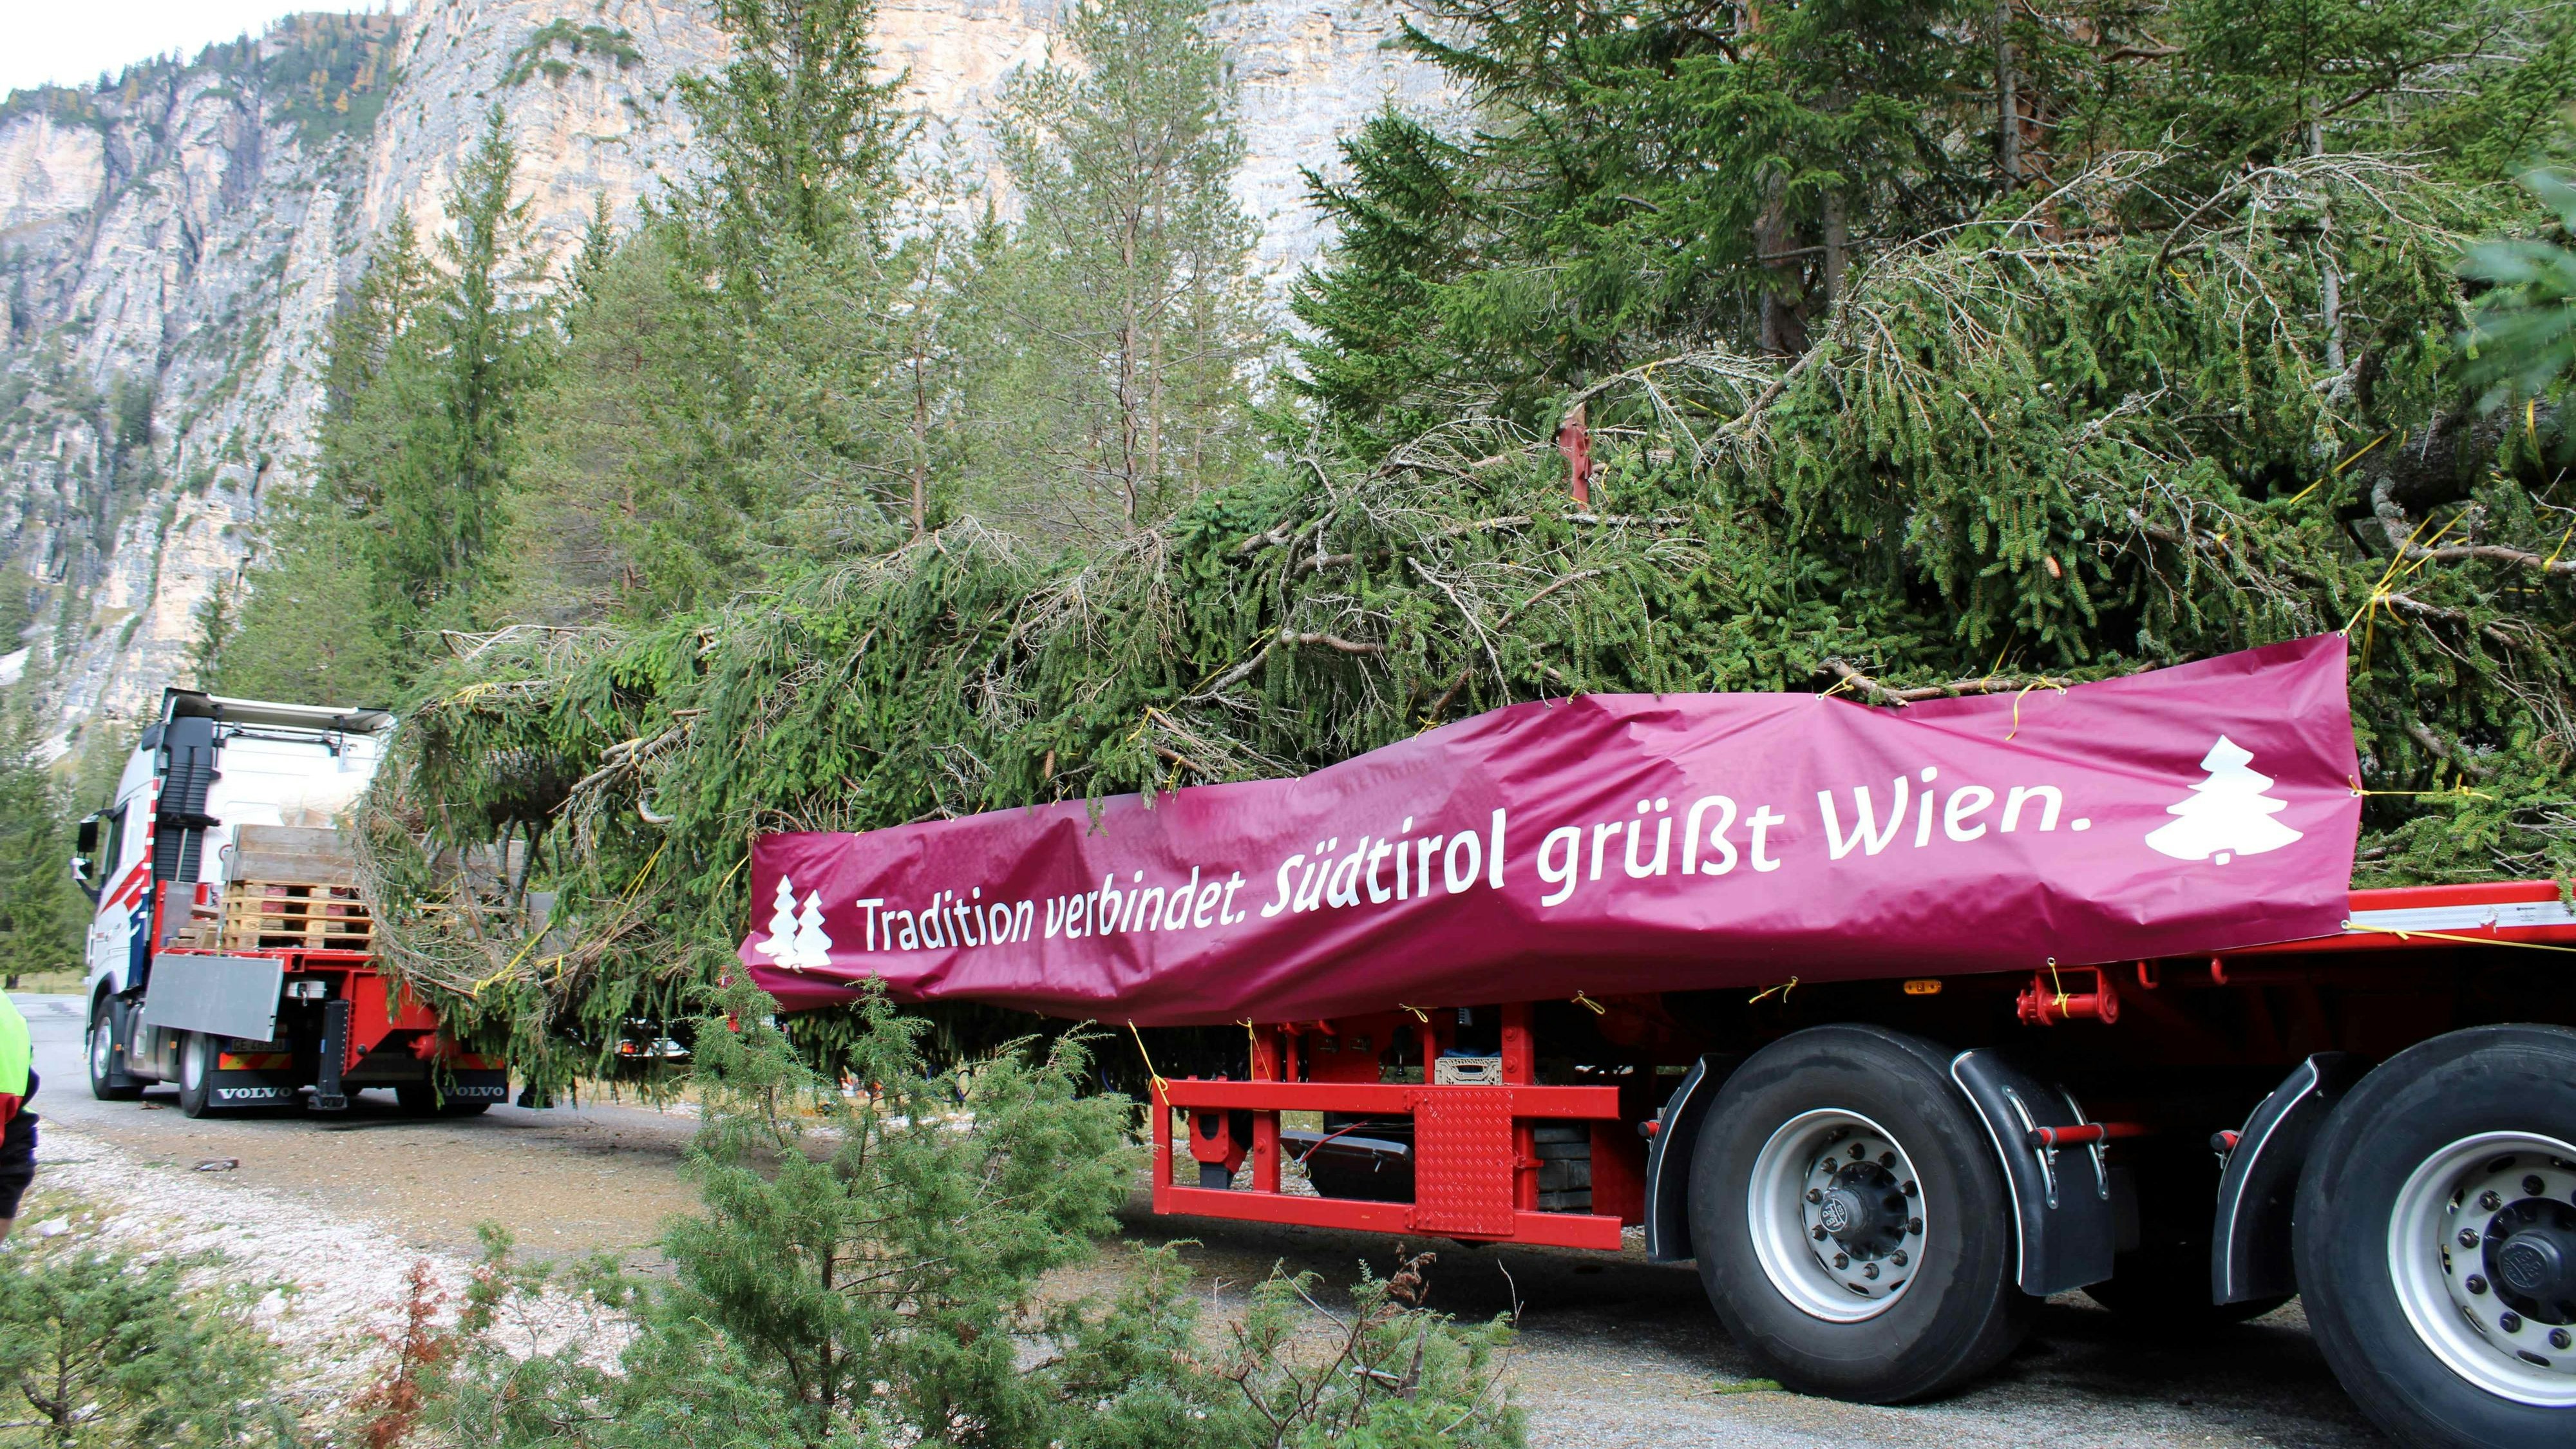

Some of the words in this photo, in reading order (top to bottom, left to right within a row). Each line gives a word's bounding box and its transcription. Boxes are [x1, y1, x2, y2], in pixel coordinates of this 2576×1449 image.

[857, 886, 1034, 951] Tradition
[1045, 866, 1246, 939] verbindet.
[1260, 808, 1506, 918] Südtirol
[1537, 794, 1786, 907] grüßt
[1817, 766, 2092, 861] Wien.
[218, 1087, 292, 1099] VOLVO
[440, 1086, 504, 1097] VOLVO
